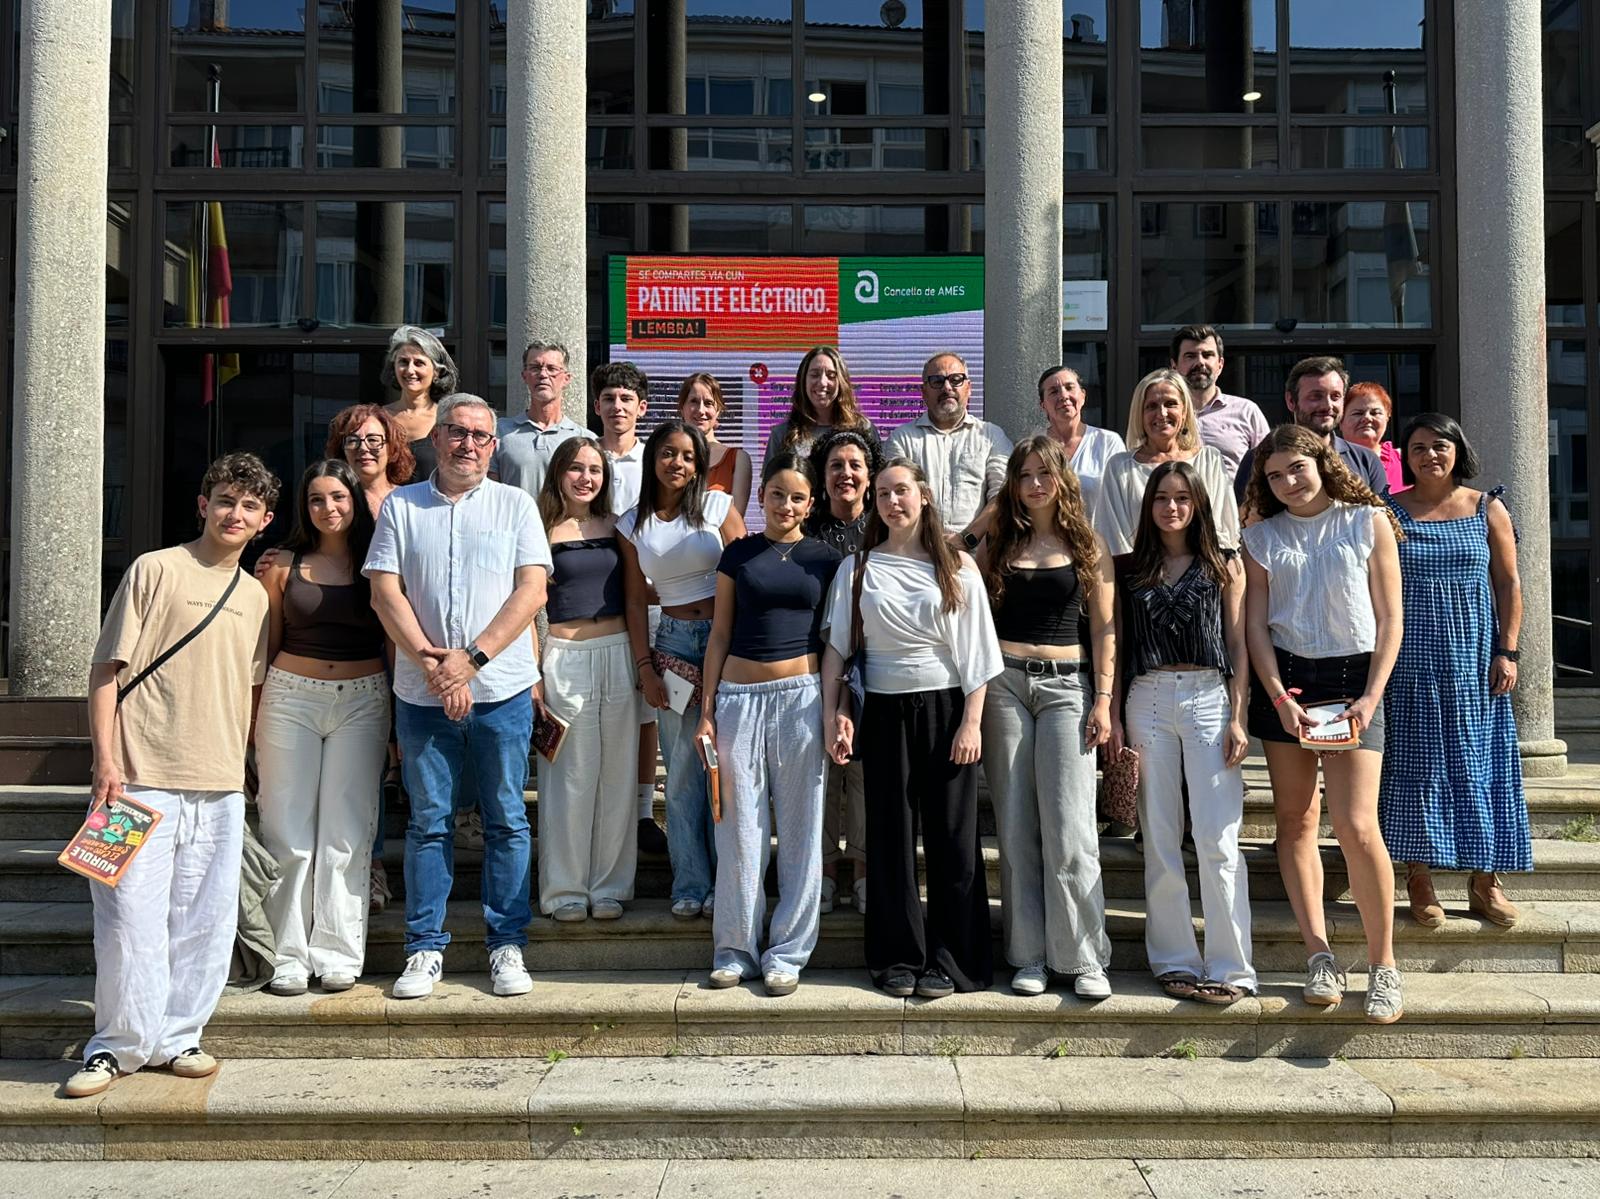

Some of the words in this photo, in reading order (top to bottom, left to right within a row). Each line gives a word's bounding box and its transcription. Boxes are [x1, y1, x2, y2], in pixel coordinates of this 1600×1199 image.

[652, 269, 707, 280] COMPARTES
[726, 269, 745, 280] CUN
[638, 286, 724, 313] PATINETE
[729, 282, 831, 313] ELÉCTRICO.
[883, 286, 922, 297] Concello
[924, 286, 935, 297] de
[938, 285, 965, 297] AMES
[638, 322, 700, 335] LEMBRA!
[70, 845, 118, 874] MURDLE
